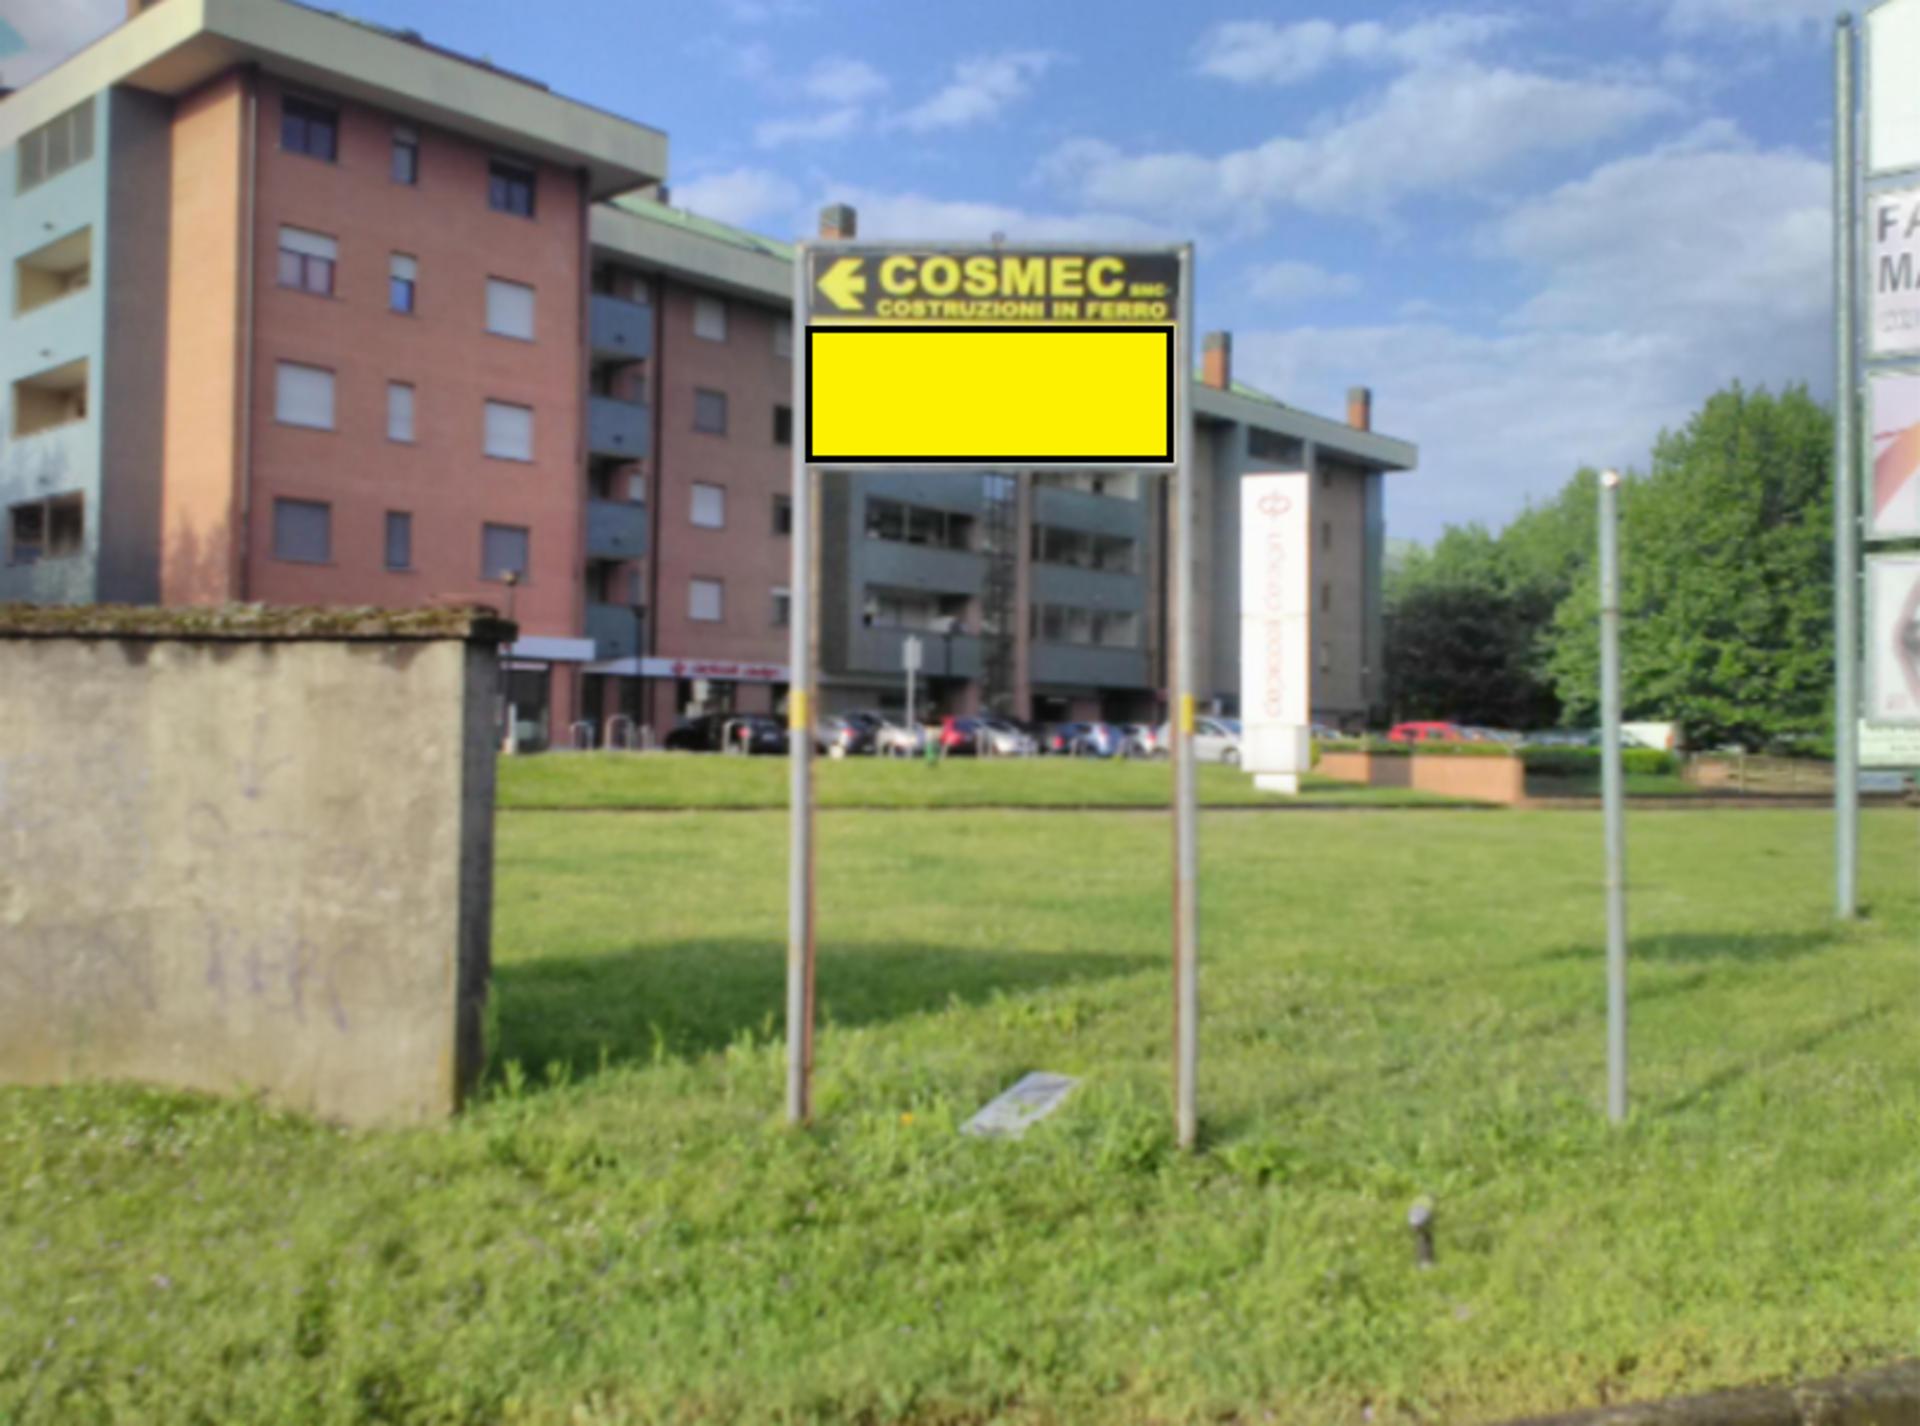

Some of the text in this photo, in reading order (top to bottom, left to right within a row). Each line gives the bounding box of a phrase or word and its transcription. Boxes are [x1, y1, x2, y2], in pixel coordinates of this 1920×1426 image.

[878, 255, 1126, 297] COSMEC
[1878, 251, 1920, 293] M
[876, 301, 1169, 320] COSTRUZIONI IN FERRO
